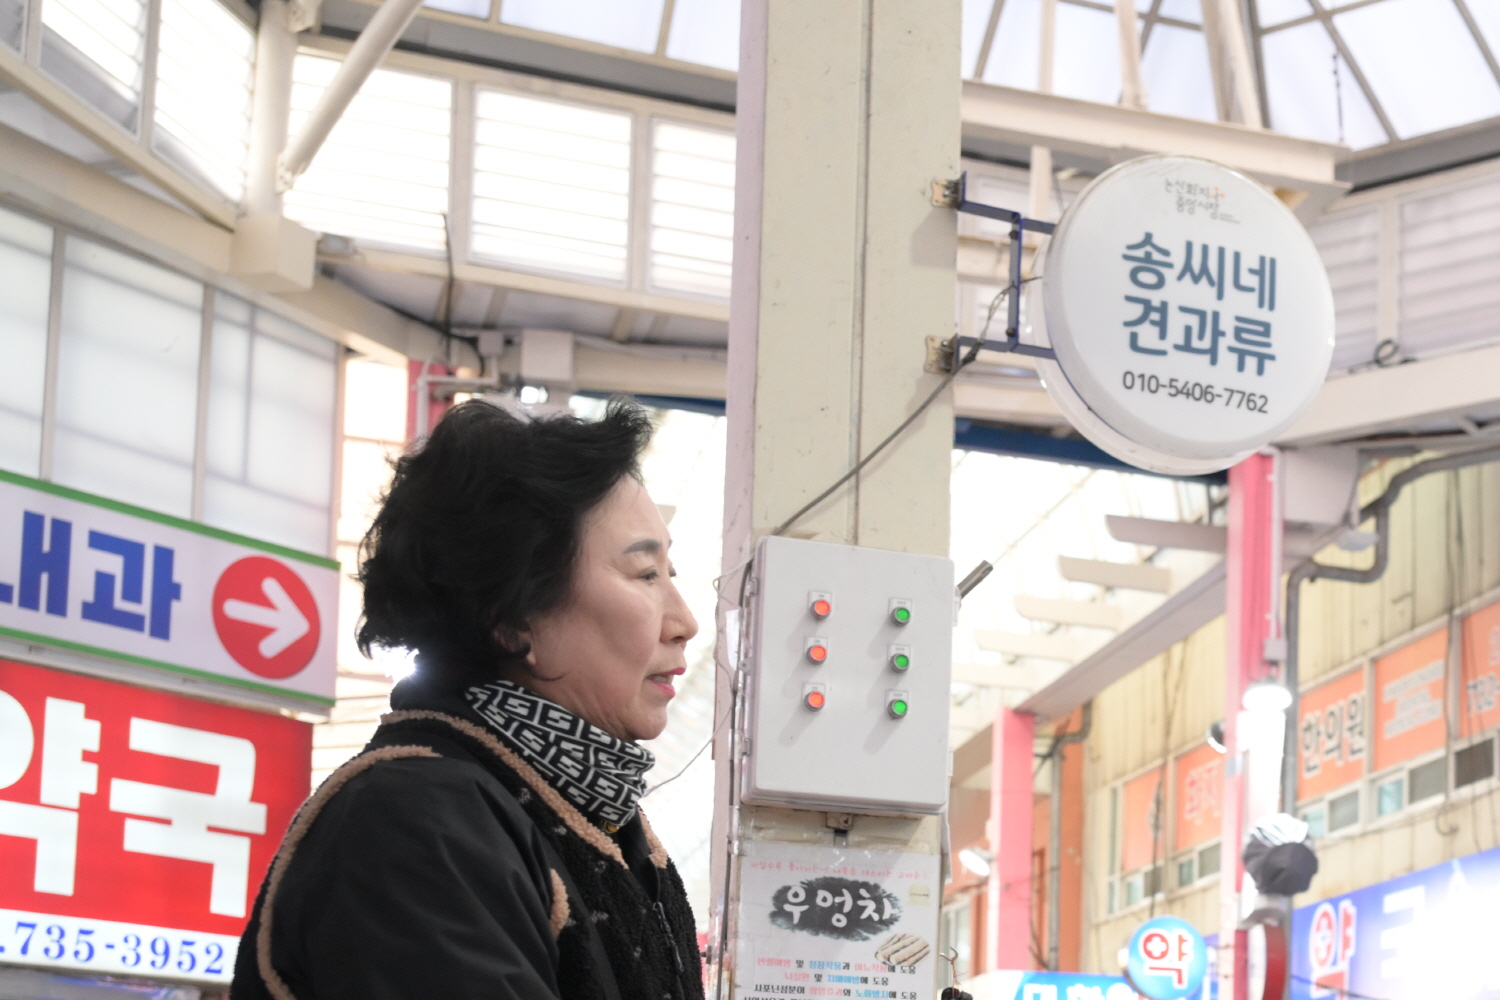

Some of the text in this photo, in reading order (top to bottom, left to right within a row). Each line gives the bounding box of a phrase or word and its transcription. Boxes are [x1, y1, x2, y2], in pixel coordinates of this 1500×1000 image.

[1121, 232, 1276, 312] 송씨네
[1122, 295, 1277, 377] 견과류
[1122, 370, 1269, 414] 010-5406-7762
[1302, 692, 1365, 778] 한의원
[0, 690, 268, 918] 약국
[783, 884, 898, 928] 우엉차
[795, 959, 804, 970] 및
[900, 965, 916, 975] 도움
[814, 973, 823, 983] 및
[873, 976, 889, 986] 도움
[1139, 928, 1193, 989] 약
[754, 984, 805, 995] 사포닌성분이
[855, 988, 897, 999] 노화방지에
[901, 990, 917, 1000] 도움
